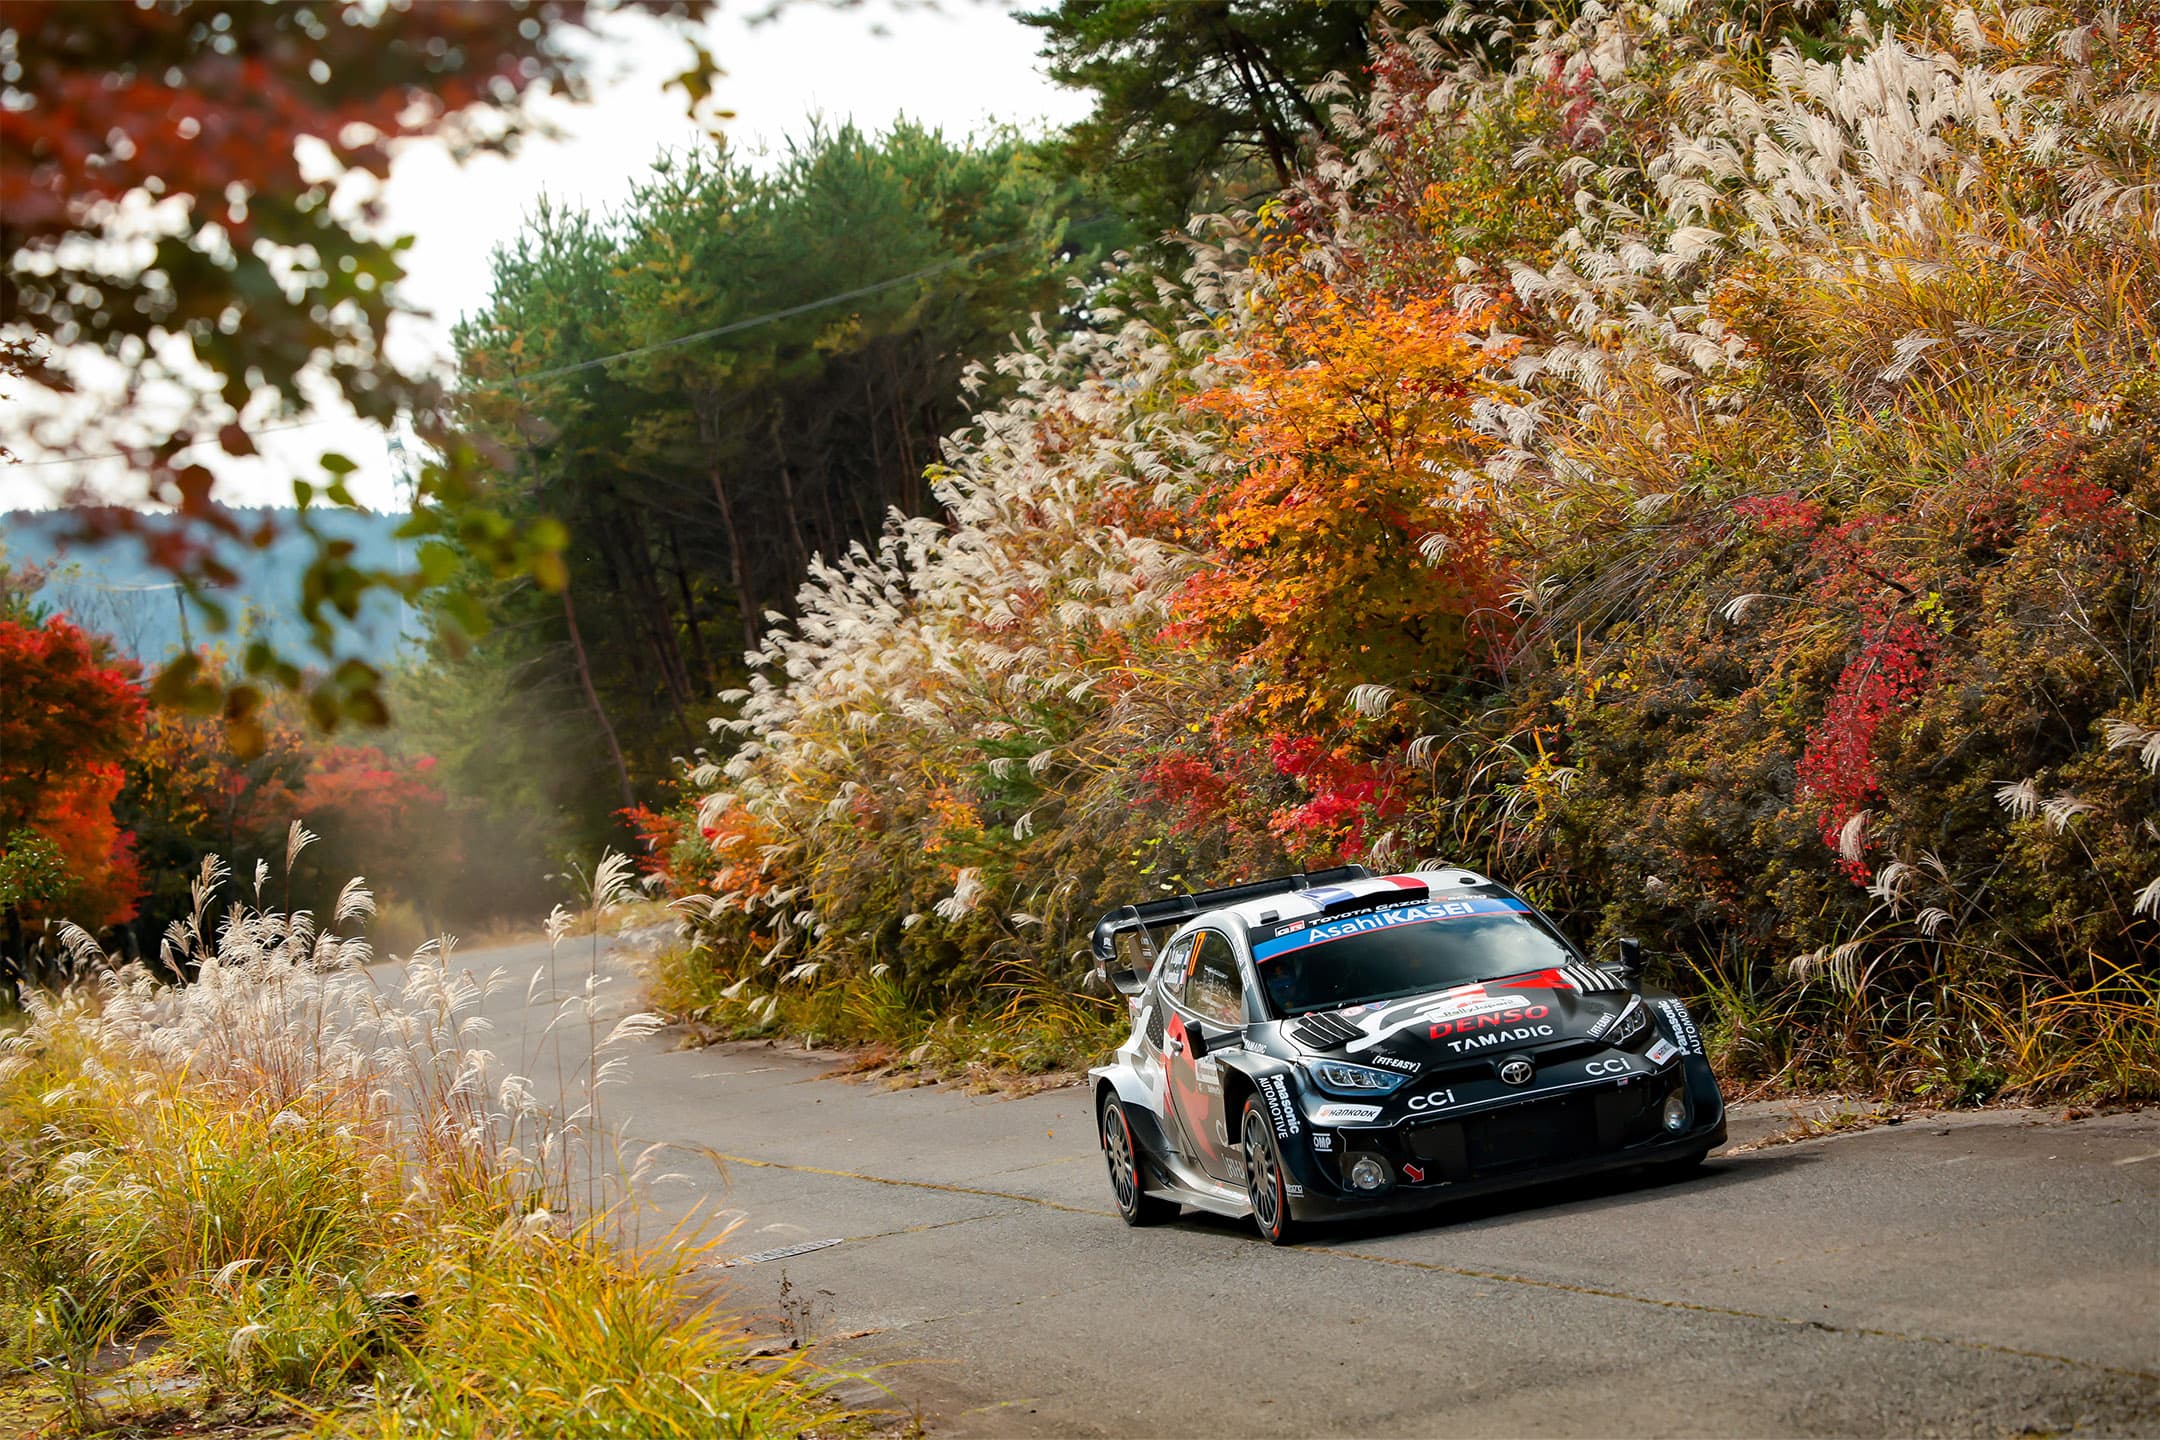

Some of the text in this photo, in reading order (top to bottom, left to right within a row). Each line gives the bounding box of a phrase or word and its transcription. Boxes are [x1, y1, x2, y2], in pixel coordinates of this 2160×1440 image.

[1308, 908, 1372, 926] TOYOTA
[1375, 898, 1433, 913] GAZOO
[1308, 902, 1475, 942] AsahiKASEI
[1429, 1005, 1549, 1040] DENSO
[1447, 1025, 1554, 1053] TAMADIC
[1658, 1000, 1691, 1057] Panasonic
[1668, 998, 1703, 1056] AUTOMOTIVE
[1585, 1058, 1631, 1076] CCI
[1258, 1077, 1289, 1139] AUTOMOTIVE
[1270, 1073, 1301, 1135] Panasonic
[1408, 1089, 1455, 1110] CCI
[1313, 1136, 1332, 1149] OMP
